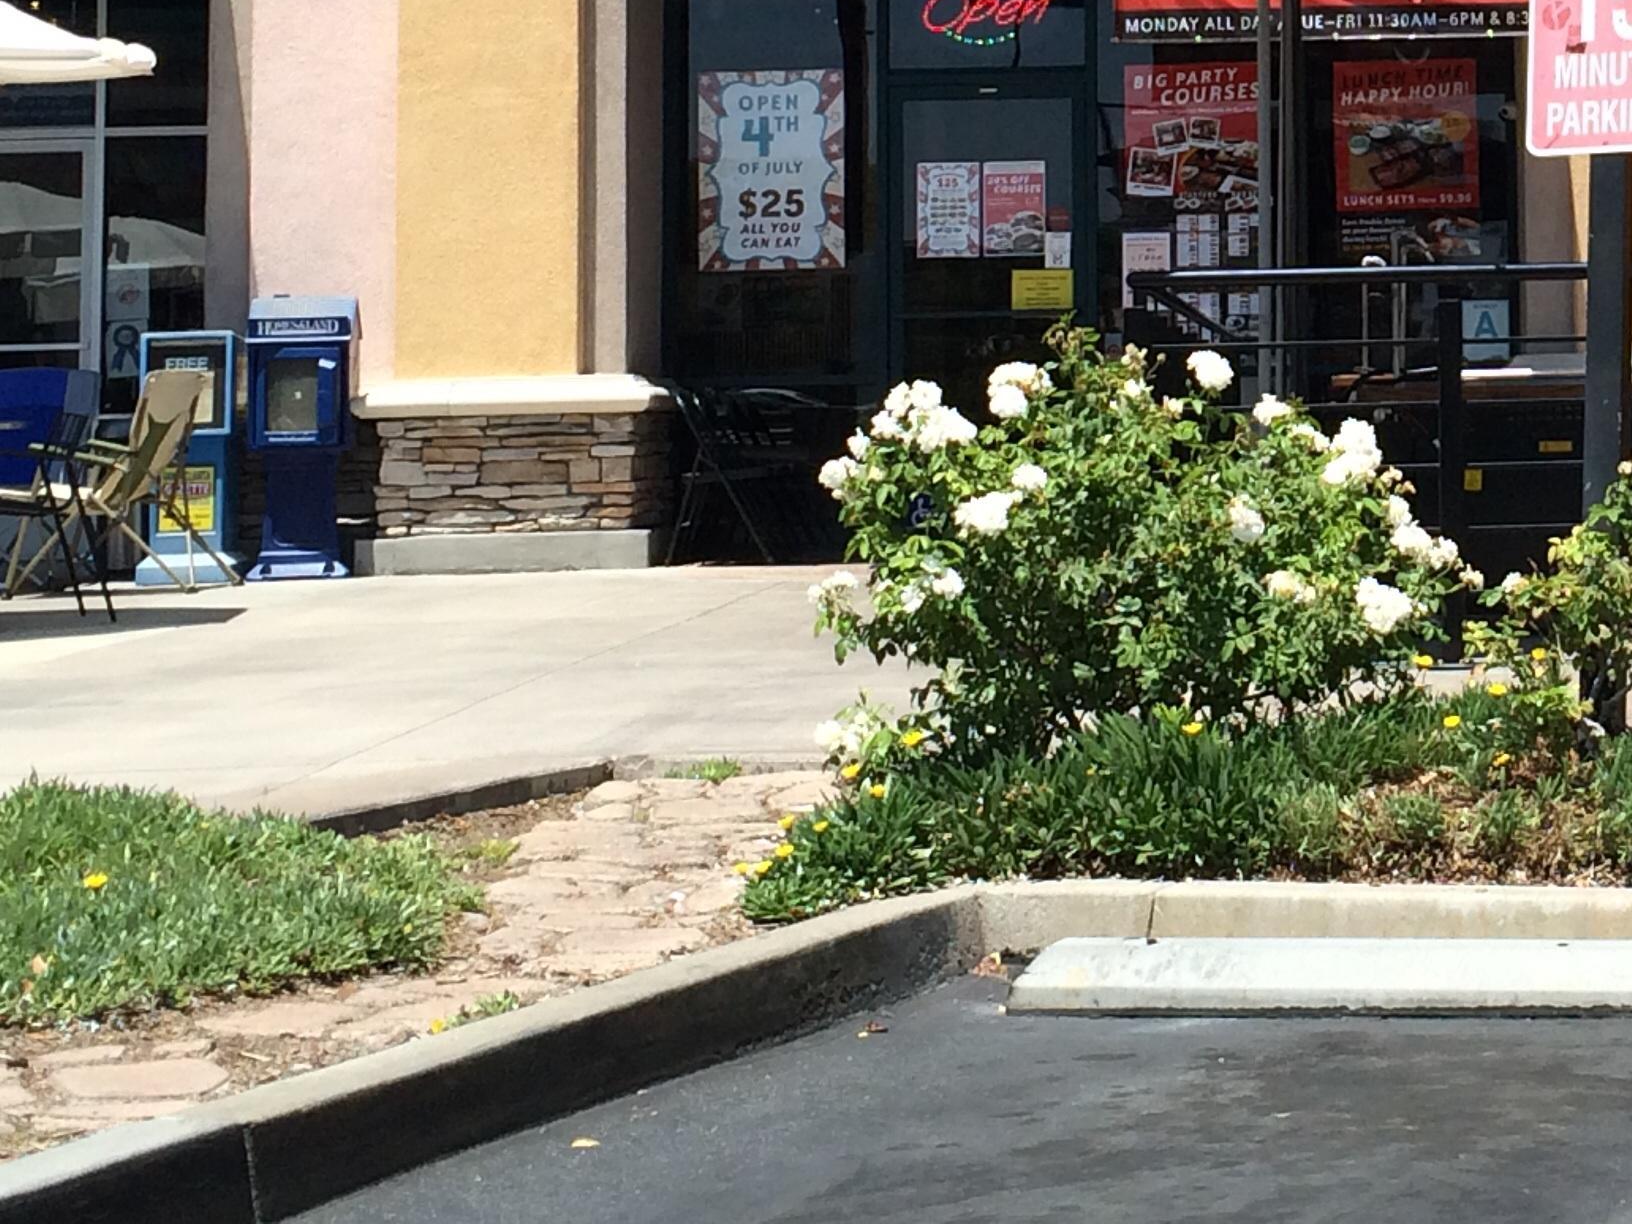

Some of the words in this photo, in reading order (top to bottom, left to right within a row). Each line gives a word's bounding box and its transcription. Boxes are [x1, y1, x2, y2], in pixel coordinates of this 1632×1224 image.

[1125, 16, 1200, 33] MONDAY
[1204, 15, 1235, 31] ALL
[1240, 15, 1273, 31] DA
[1301, 13, 1362, 30] UE-FRI
[1489, 11, 1501, 26] &
[1133, 73, 1168, 90] BIG
[1175, 67, 1238, 86] PARTY
[738, 94, 799, 111] OPEN
[1160, 81, 1259, 106] COURSES
[1340, 86, 1403, 106] HAPPY
[1408, 81, 1469, 100] HOUR!
[738, 162, 759, 175] OF
[765, 160, 803, 176] JULY
[738, 187, 804, 221] $25
[1343, 195, 1383, 206] LUNCH
[1386, 194, 1415, 205] SETS
[740, 222, 766, 234] ALL
[771, 222, 801, 233] YOU
[740, 237, 769, 248] CAN
[775, 236, 801, 248] EAT
[1474, 310, 1499, 338] A
[165, 356, 209, 371] FREE
